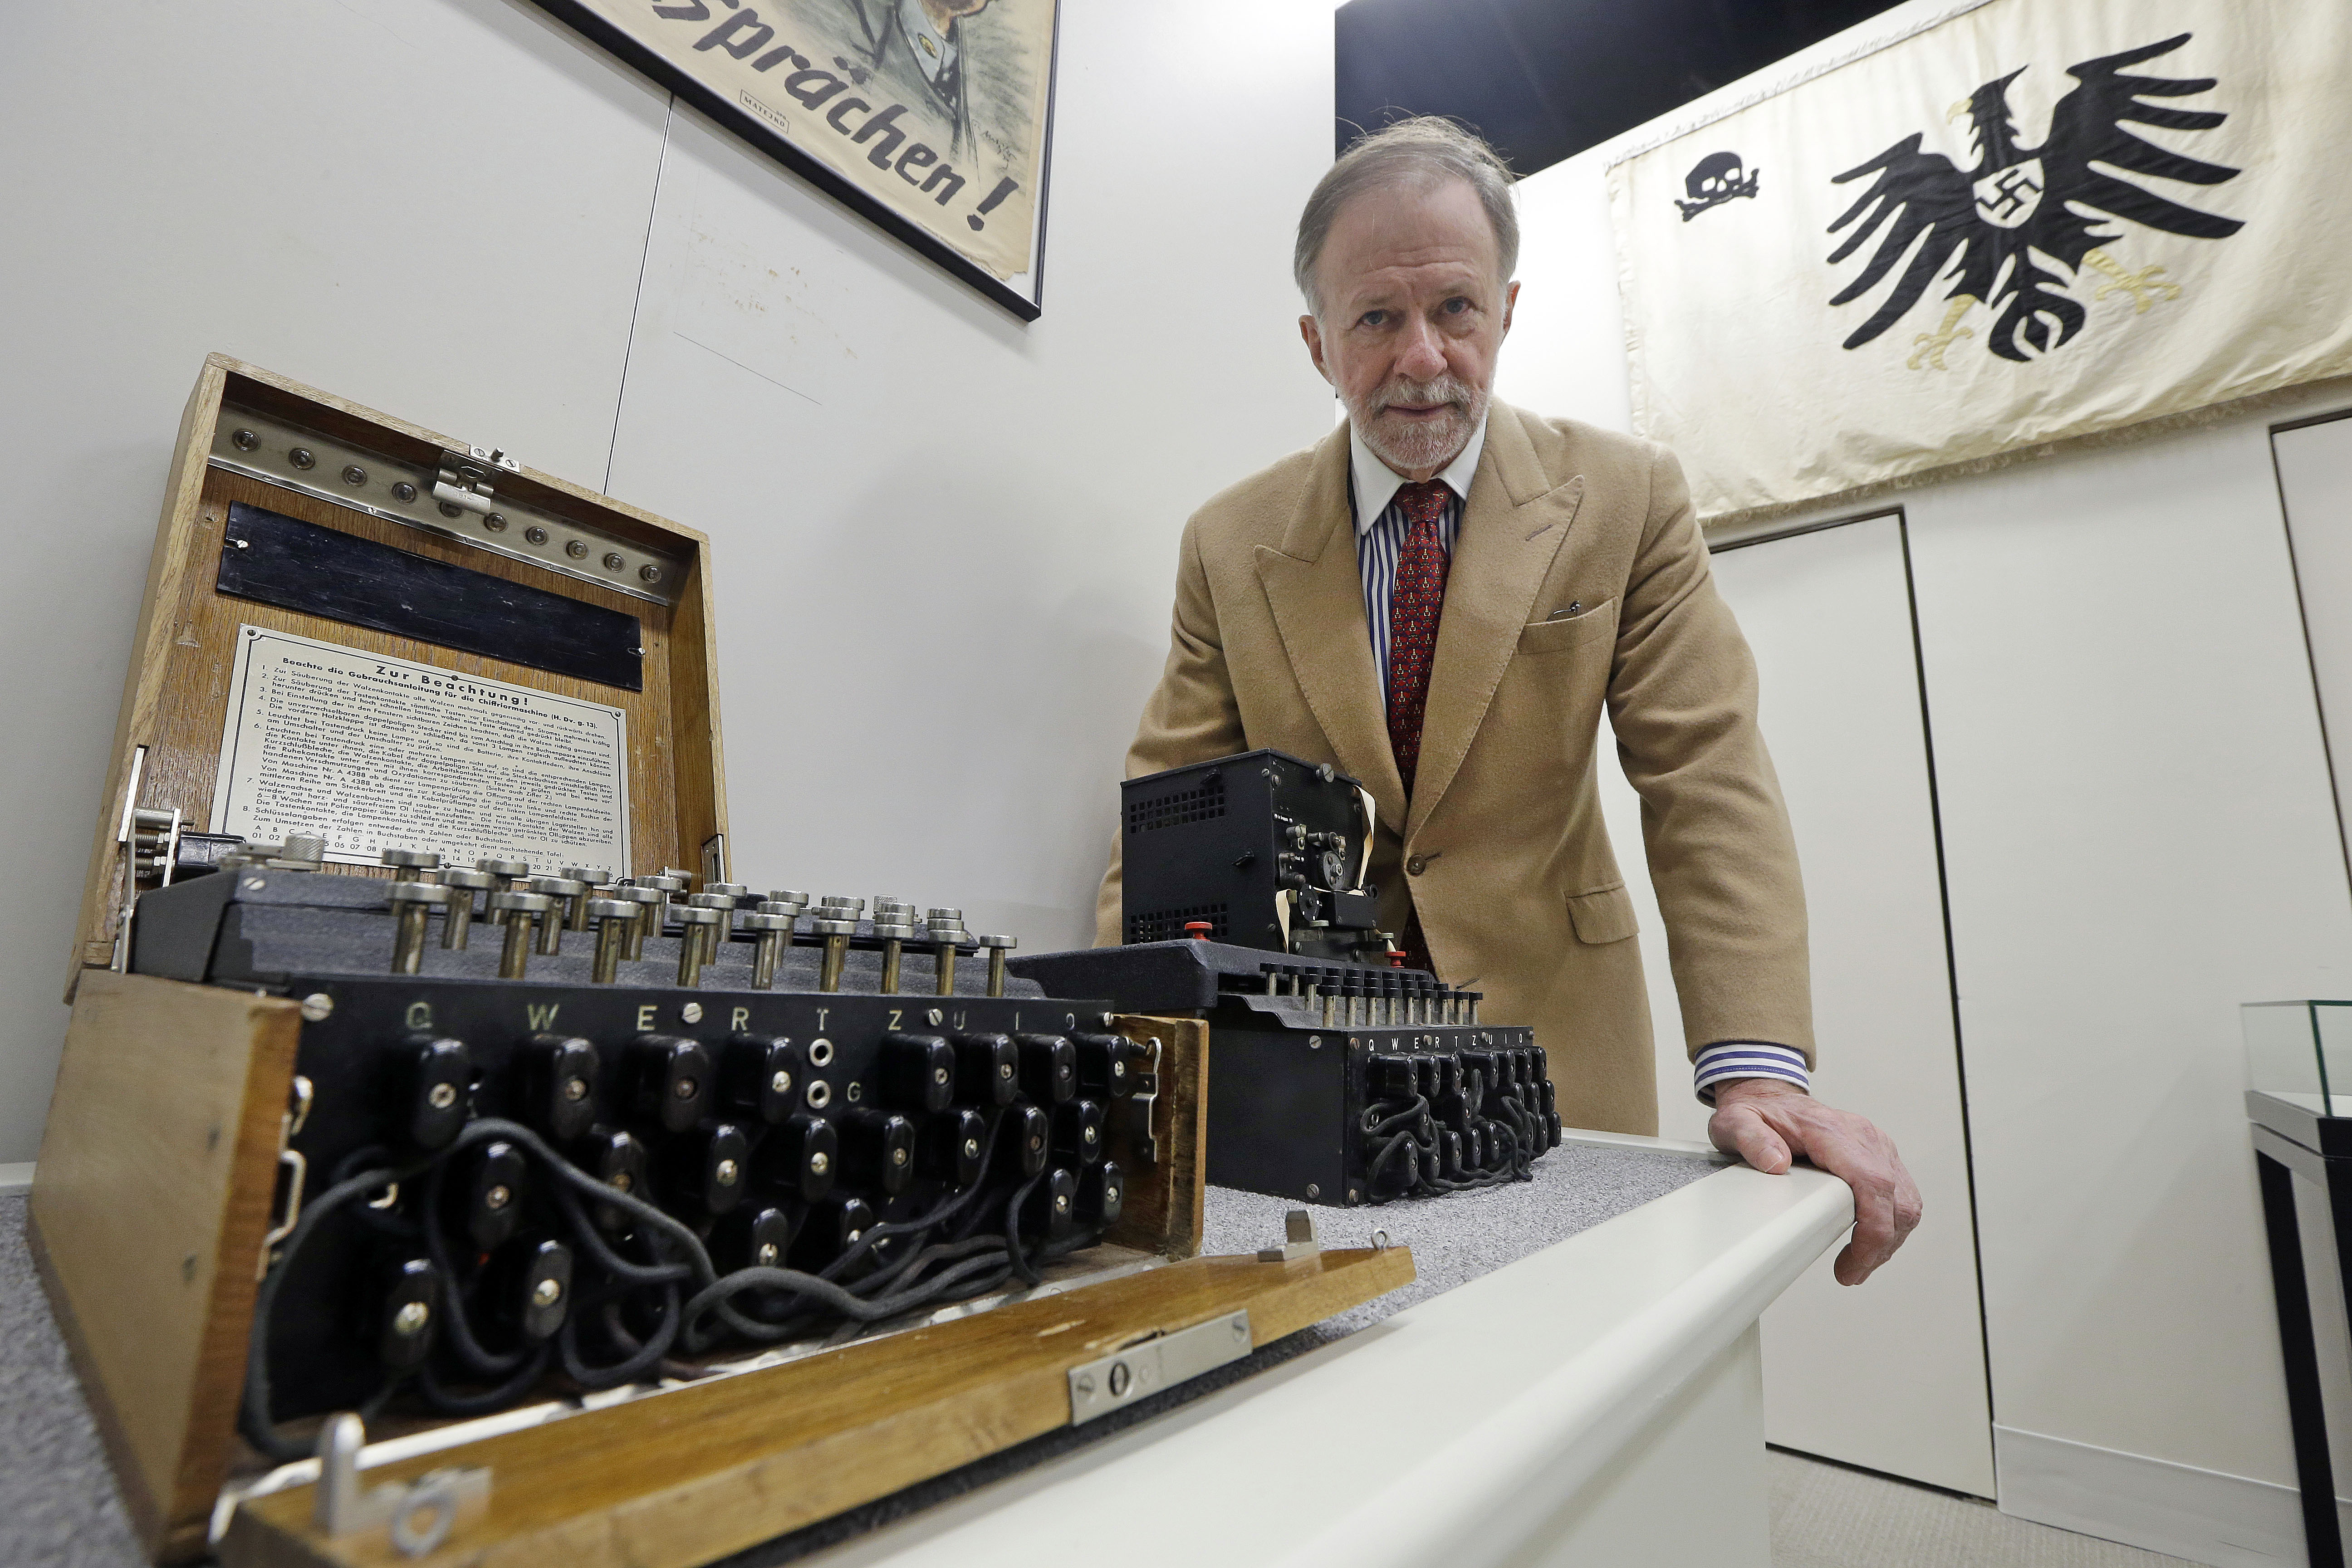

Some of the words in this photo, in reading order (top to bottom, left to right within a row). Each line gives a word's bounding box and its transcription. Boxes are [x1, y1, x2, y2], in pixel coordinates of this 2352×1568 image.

[744, 96, 785, 127] MATEJKO
[272, 681, 305, 692] herunter
[309, 688, 338, 698] drücken
[379, 703, 411, 712] schnellen
[415, 709, 437, 718] lassen,
[498, 725, 524, 735] dauernd
[283, 657, 323, 671] Beachte
[348, 671, 441, 696] Gebrauchsanleitung
[478, 698, 548, 718] Chiffriermaschine
[291, 671, 333, 684] Säuberung
[353, 683, 410, 699] Walzenkontakte
[429, 698, 455, 708] Walzen
[458, 706, 488, 715] mehrmals
[490, 712, 526, 723] gegenseitig
[557, 725, 583, 735] rückwärts
[585, 731, 606, 739] drehen.
[375, 665, 410, 680] Zur
[421, 675, 528, 706] Beachtung!
[287, 691, 328, 705] Einstellung
[374, 708, 403, 718] Fenstern
[406, 715, 440, 725] sichtbaren
[442, 721, 467, 730] Zeichen
[470, 726, 500, 737] beachten,
[529, 738, 552, 747] Walzen
[554, 743, 572, 751] richtig
[288, 701, 360, 718] unverwechselbaren
[363, 715, 415, 728] doppelpoligen
[417, 724, 442, 733] Stecker
[485, 737, 513, 748] Anschlag
[536, 747, 576, 759] Buchsenpaare
[578, 755, 611, 765] einzuführen.
[288, 707, 320, 716] vordere
[322, 712, 364, 725] Holzklappe
[381, 723, 407, 732] danach
[423, 732, 456, 742] schließen,
[499, 745, 523, 754] Lampen
[554, 756, 586, 765] aufleuchten
[590, 762, 612, 770] können.
[290, 679, 332, 692] Säuberung
[353, 691, 406, 706] Tastenkontakte
[410, 703, 441, 712] sämtliche
[446, 709, 466, 717] Tasten
[483, 717, 520, 730] Einschaltung
[538, 728, 560, 737] Stromes
[564, 735, 590, 743] mehrmals
[593, 739, 610, 748] kräftig
[281, 760, 318, 770] Maschine
[418, 781, 470, 795] Lampenprüfung
[486, 791, 512, 801] Öffnung
[565, 804, 612, 816] Lampenfeldseite.
[255, 807, 328, 822] Schlüsselangaben
[332, 818, 364, 826] erfolgen
[475, 835, 513, 845] Buchstaben.
[275, 818, 314, 828] Umsetzen
[336, 825, 362, 833] Zahlen
[377, 830, 418, 841] Buchstaben
[500, 847, 544, 856] nachstehende
[406, 1001, 432, 1029] Q
[528, 1004, 559, 1030] W
[637, 1005, 657, 1031] E
[731, 1007, 749, 1031] R
[817, 1008, 829, 1030] T
[888, 1010, 902, 1030] Z
[954, 1011, 965, 1030] U
[1066, 1013, 1075, 1029] O
[1369, 1039, 1374, 1051] Q
[1392, 1038, 1399, 1050] W
[1414, 1037, 1419, 1049] E
[1435, 1036, 1440, 1048] R
[1455, 1036, 1458, 1047] T
[1472, 1035, 1476, 1046] Z
[1488, 1034, 1493, 1045] U
[1519, 1033, 1523, 1043] O
